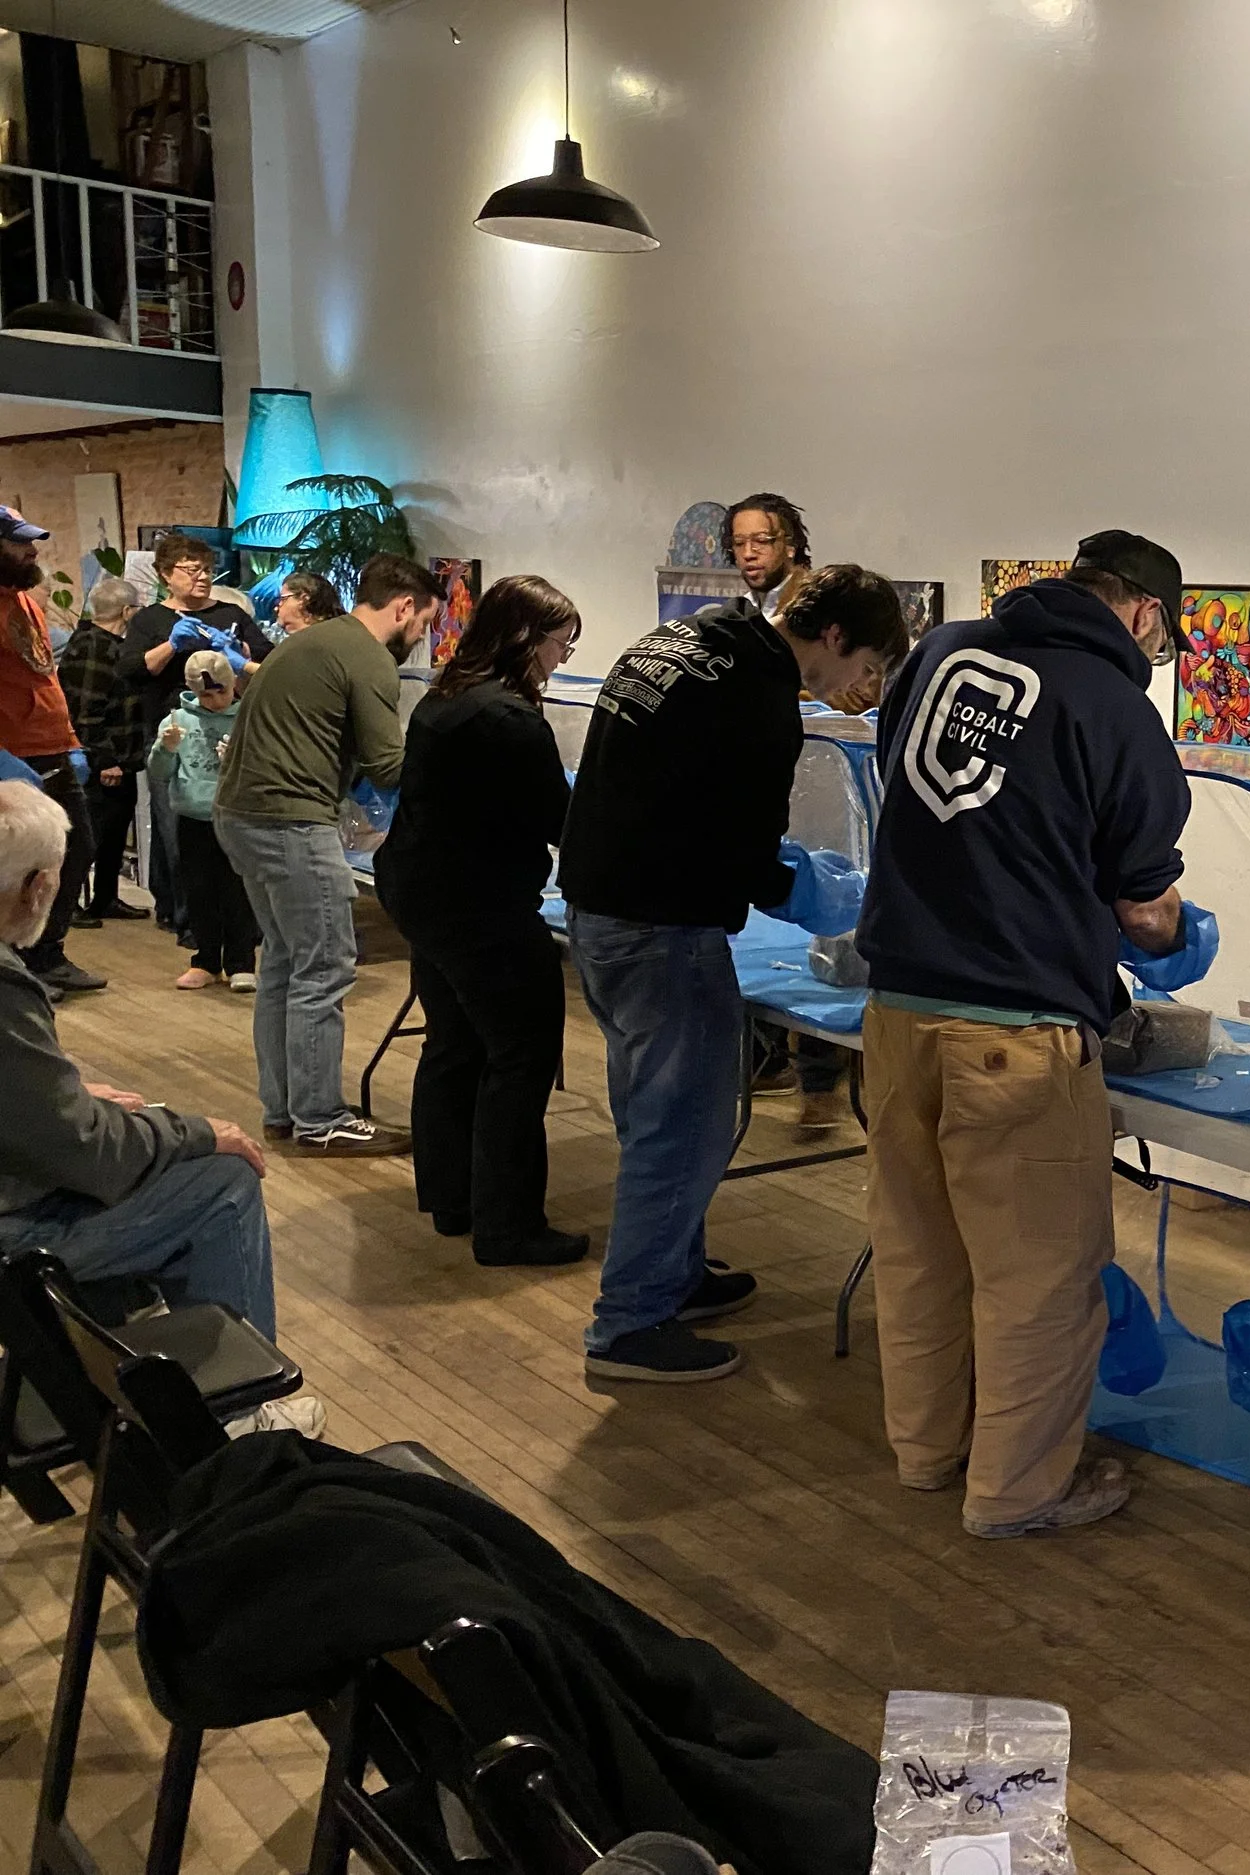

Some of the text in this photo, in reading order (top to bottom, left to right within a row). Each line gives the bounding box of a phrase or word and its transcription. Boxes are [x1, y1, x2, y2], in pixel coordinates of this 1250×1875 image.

[626, 656, 684, 692] MAYHEM
[947, 722, 987, 752] CIVIL
[952, 701, 1024, 741] COBALT
